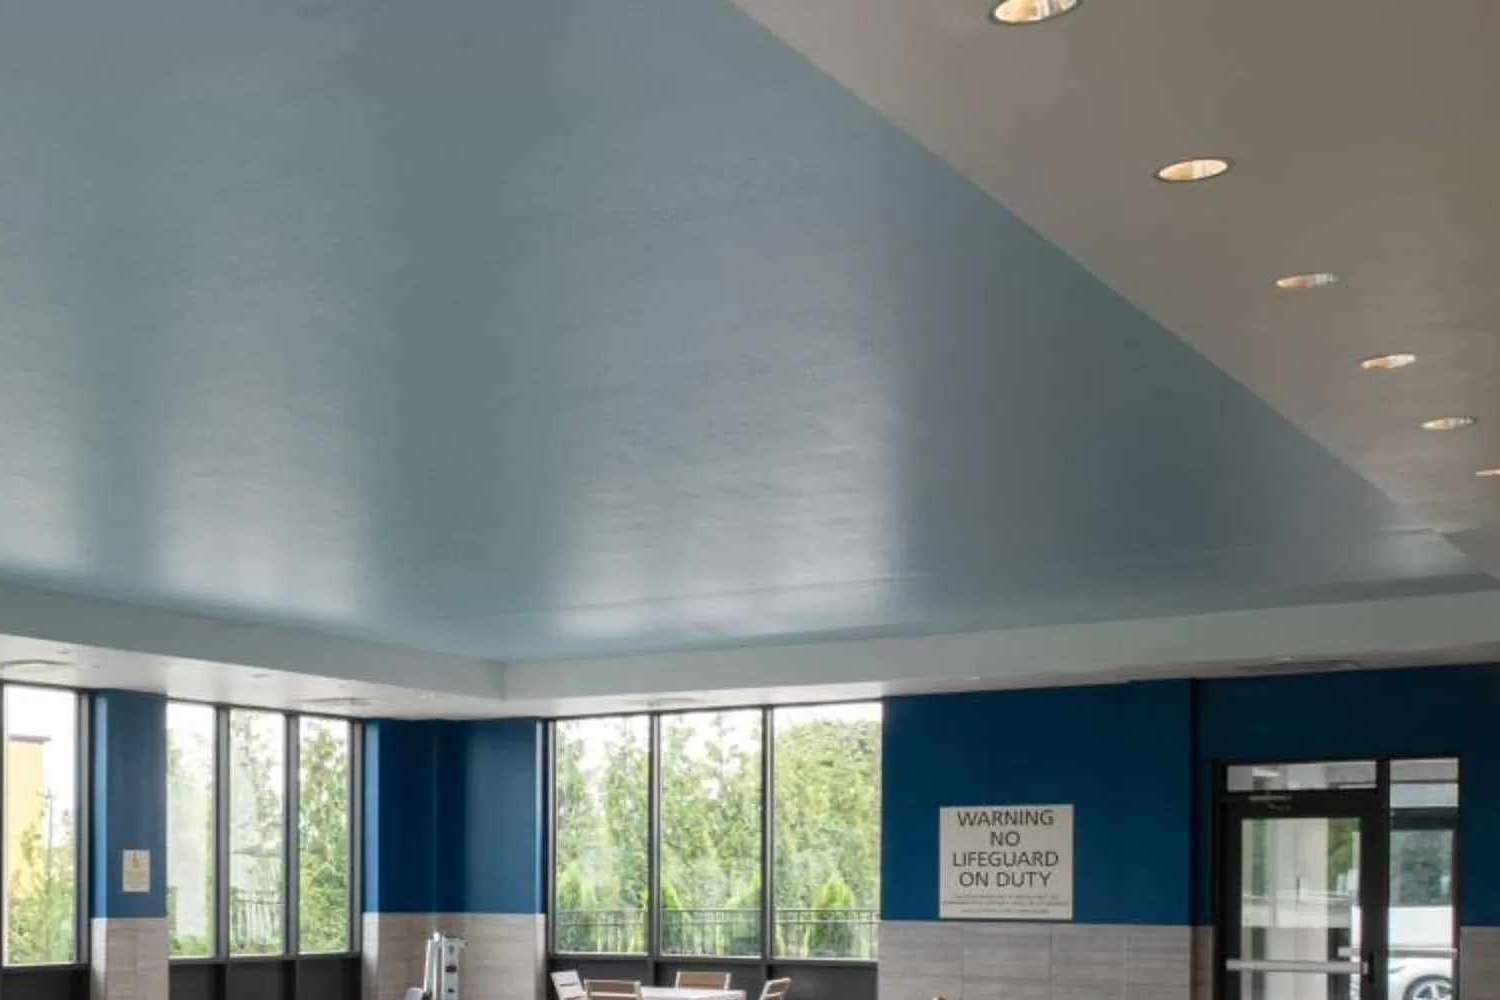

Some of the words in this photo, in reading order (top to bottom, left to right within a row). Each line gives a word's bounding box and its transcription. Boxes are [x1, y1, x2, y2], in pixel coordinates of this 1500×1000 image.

[957, 809, 1054, 827] WARNING
[989, 831, 1021, 847] NO
[953, 851, 1059, 867] LIFEGUARD
[959, 871, 989, 888] ON
[996, 871, 1052, 888] DUTY
